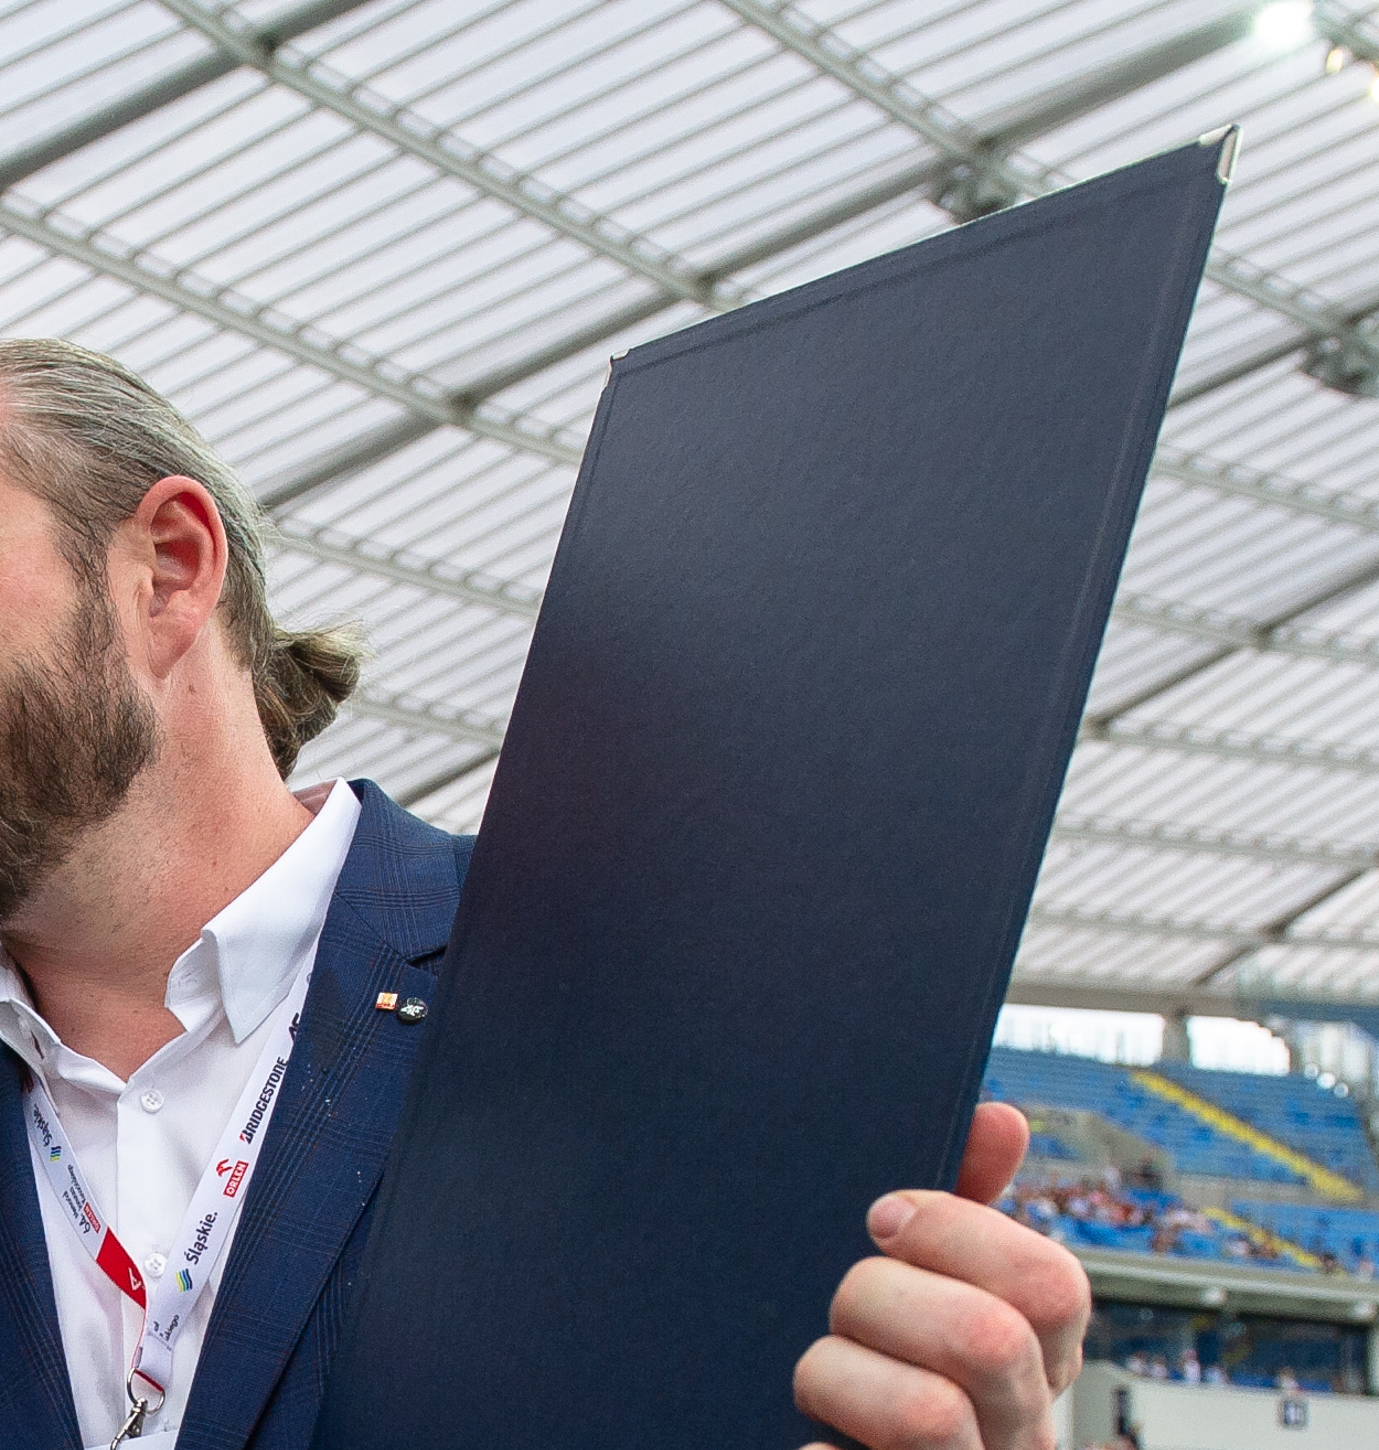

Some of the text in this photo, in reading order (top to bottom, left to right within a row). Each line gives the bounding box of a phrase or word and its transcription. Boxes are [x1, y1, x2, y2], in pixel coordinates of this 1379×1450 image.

[239, 1057, 289, 1144] BRIDGESTONE
[224, 1161, 248, 1197] ORLEN
[184, 1212, 218, 1265] Śląskie.
